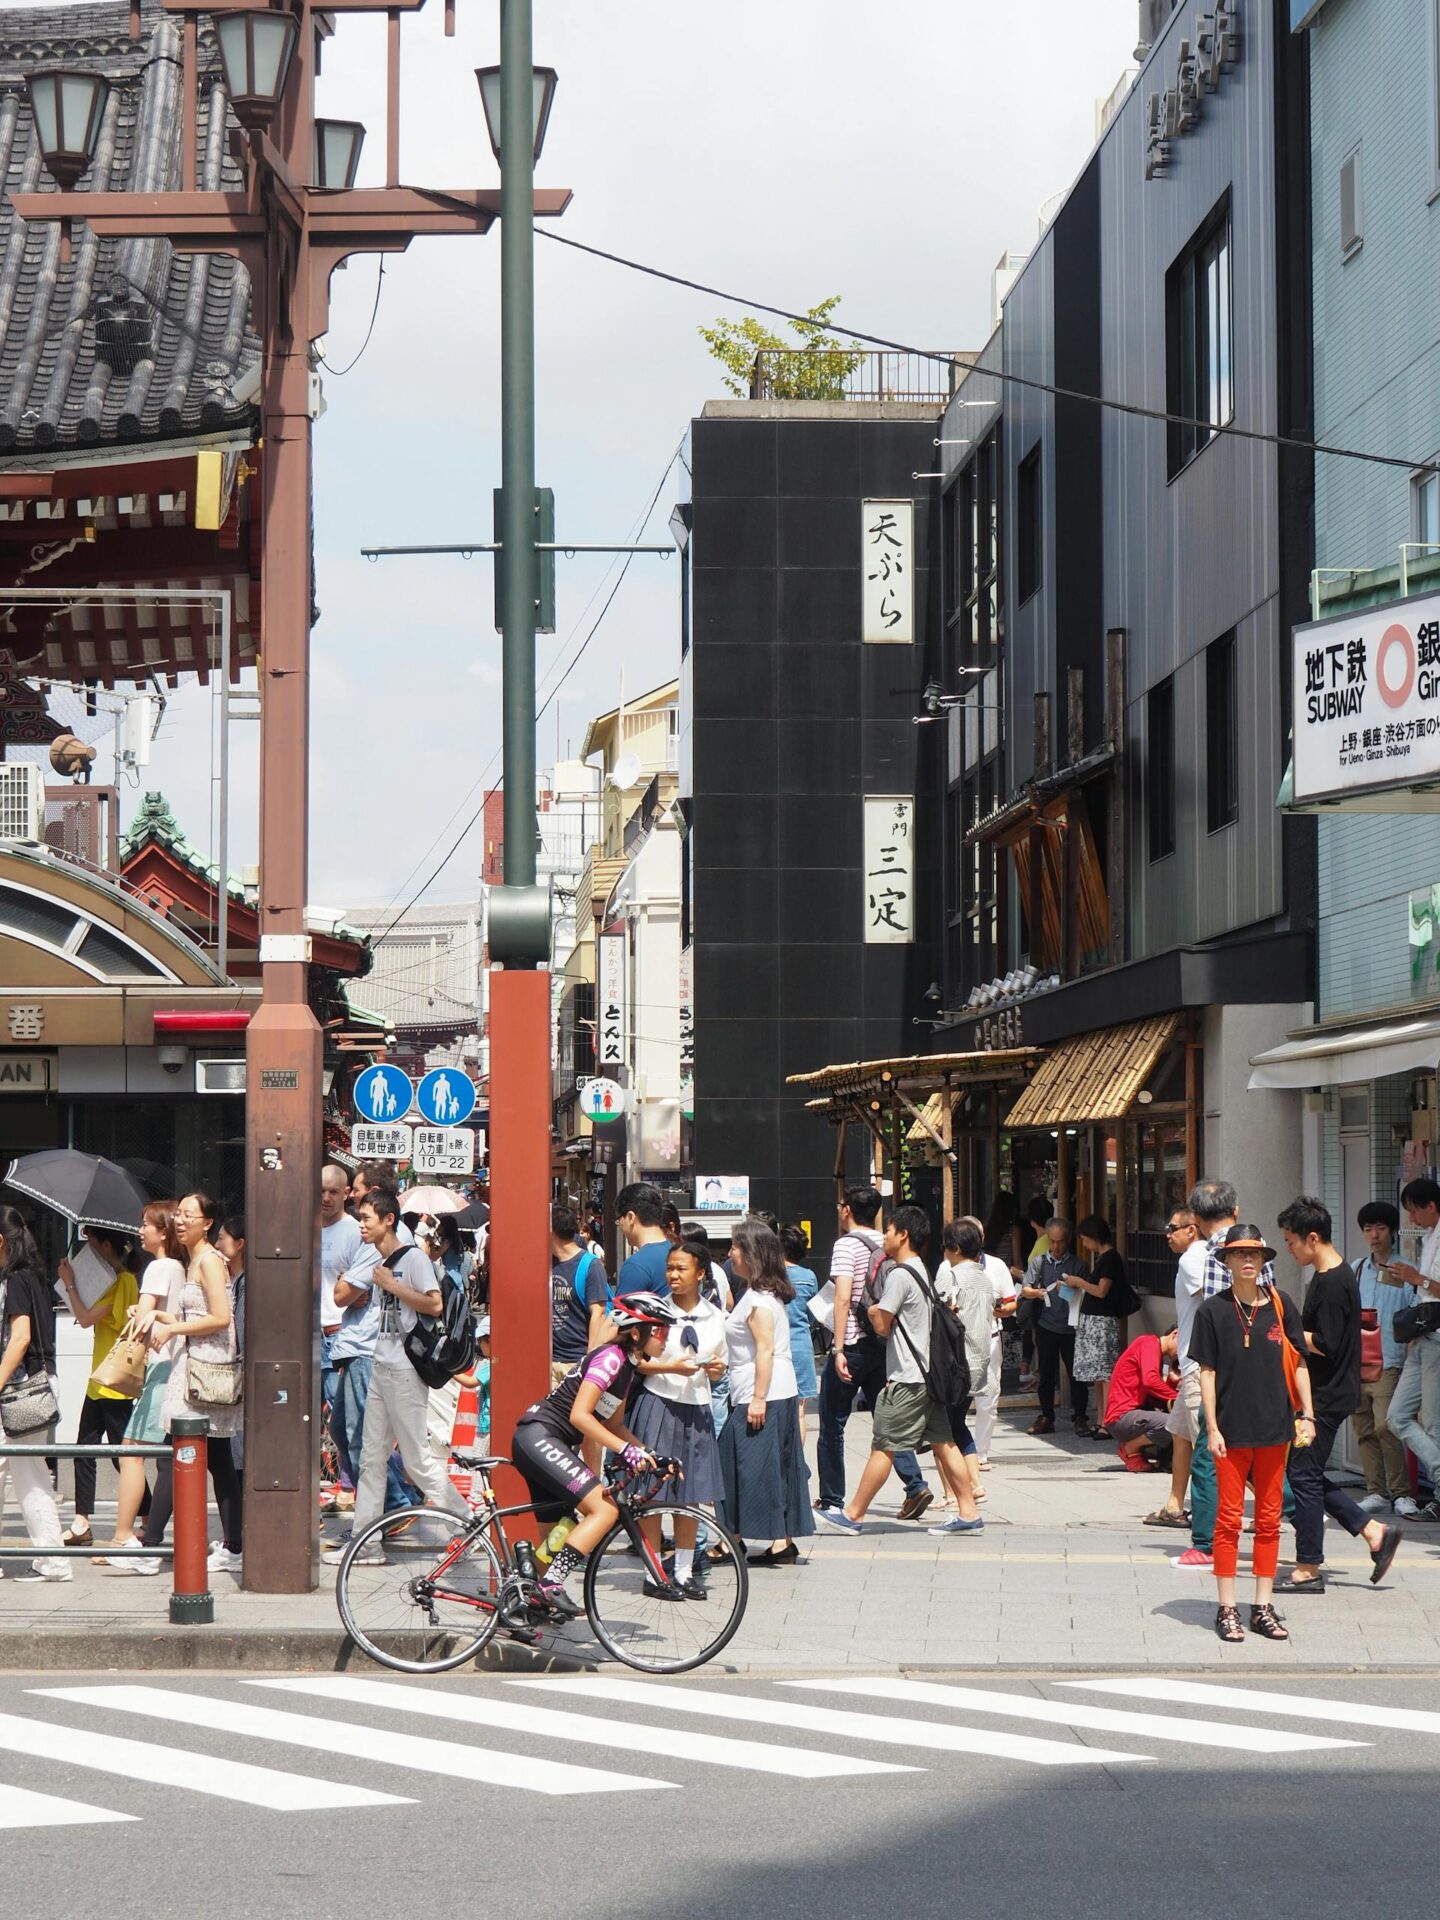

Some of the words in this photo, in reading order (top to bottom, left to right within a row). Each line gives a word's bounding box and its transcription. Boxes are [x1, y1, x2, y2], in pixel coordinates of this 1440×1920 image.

[868, 513, 904, 629] 天ぷら
[1305, 637, 1367, 695] 地下鉄
[1307, 684, 1366, 725] SUBWAY
[1339, 754, 1347, 766] for
[893, 803, 909, 837] 雷門
[868, 846, 909, 931] 三定
[608, 938, 618, 975] とんかつ
[8, 1005, 45, 1040] 番
[605, 1004, 620, 1059] とん久
[357, 1129, 406, 1141] 自転車を除く
[357, 1142, 406, 1155] 仲見世通り
[419, 1132, 445, 1143] 自転車
[419, 1144, 445, 1155] 人力車
[448, 1139, 469, 1150] を除く
